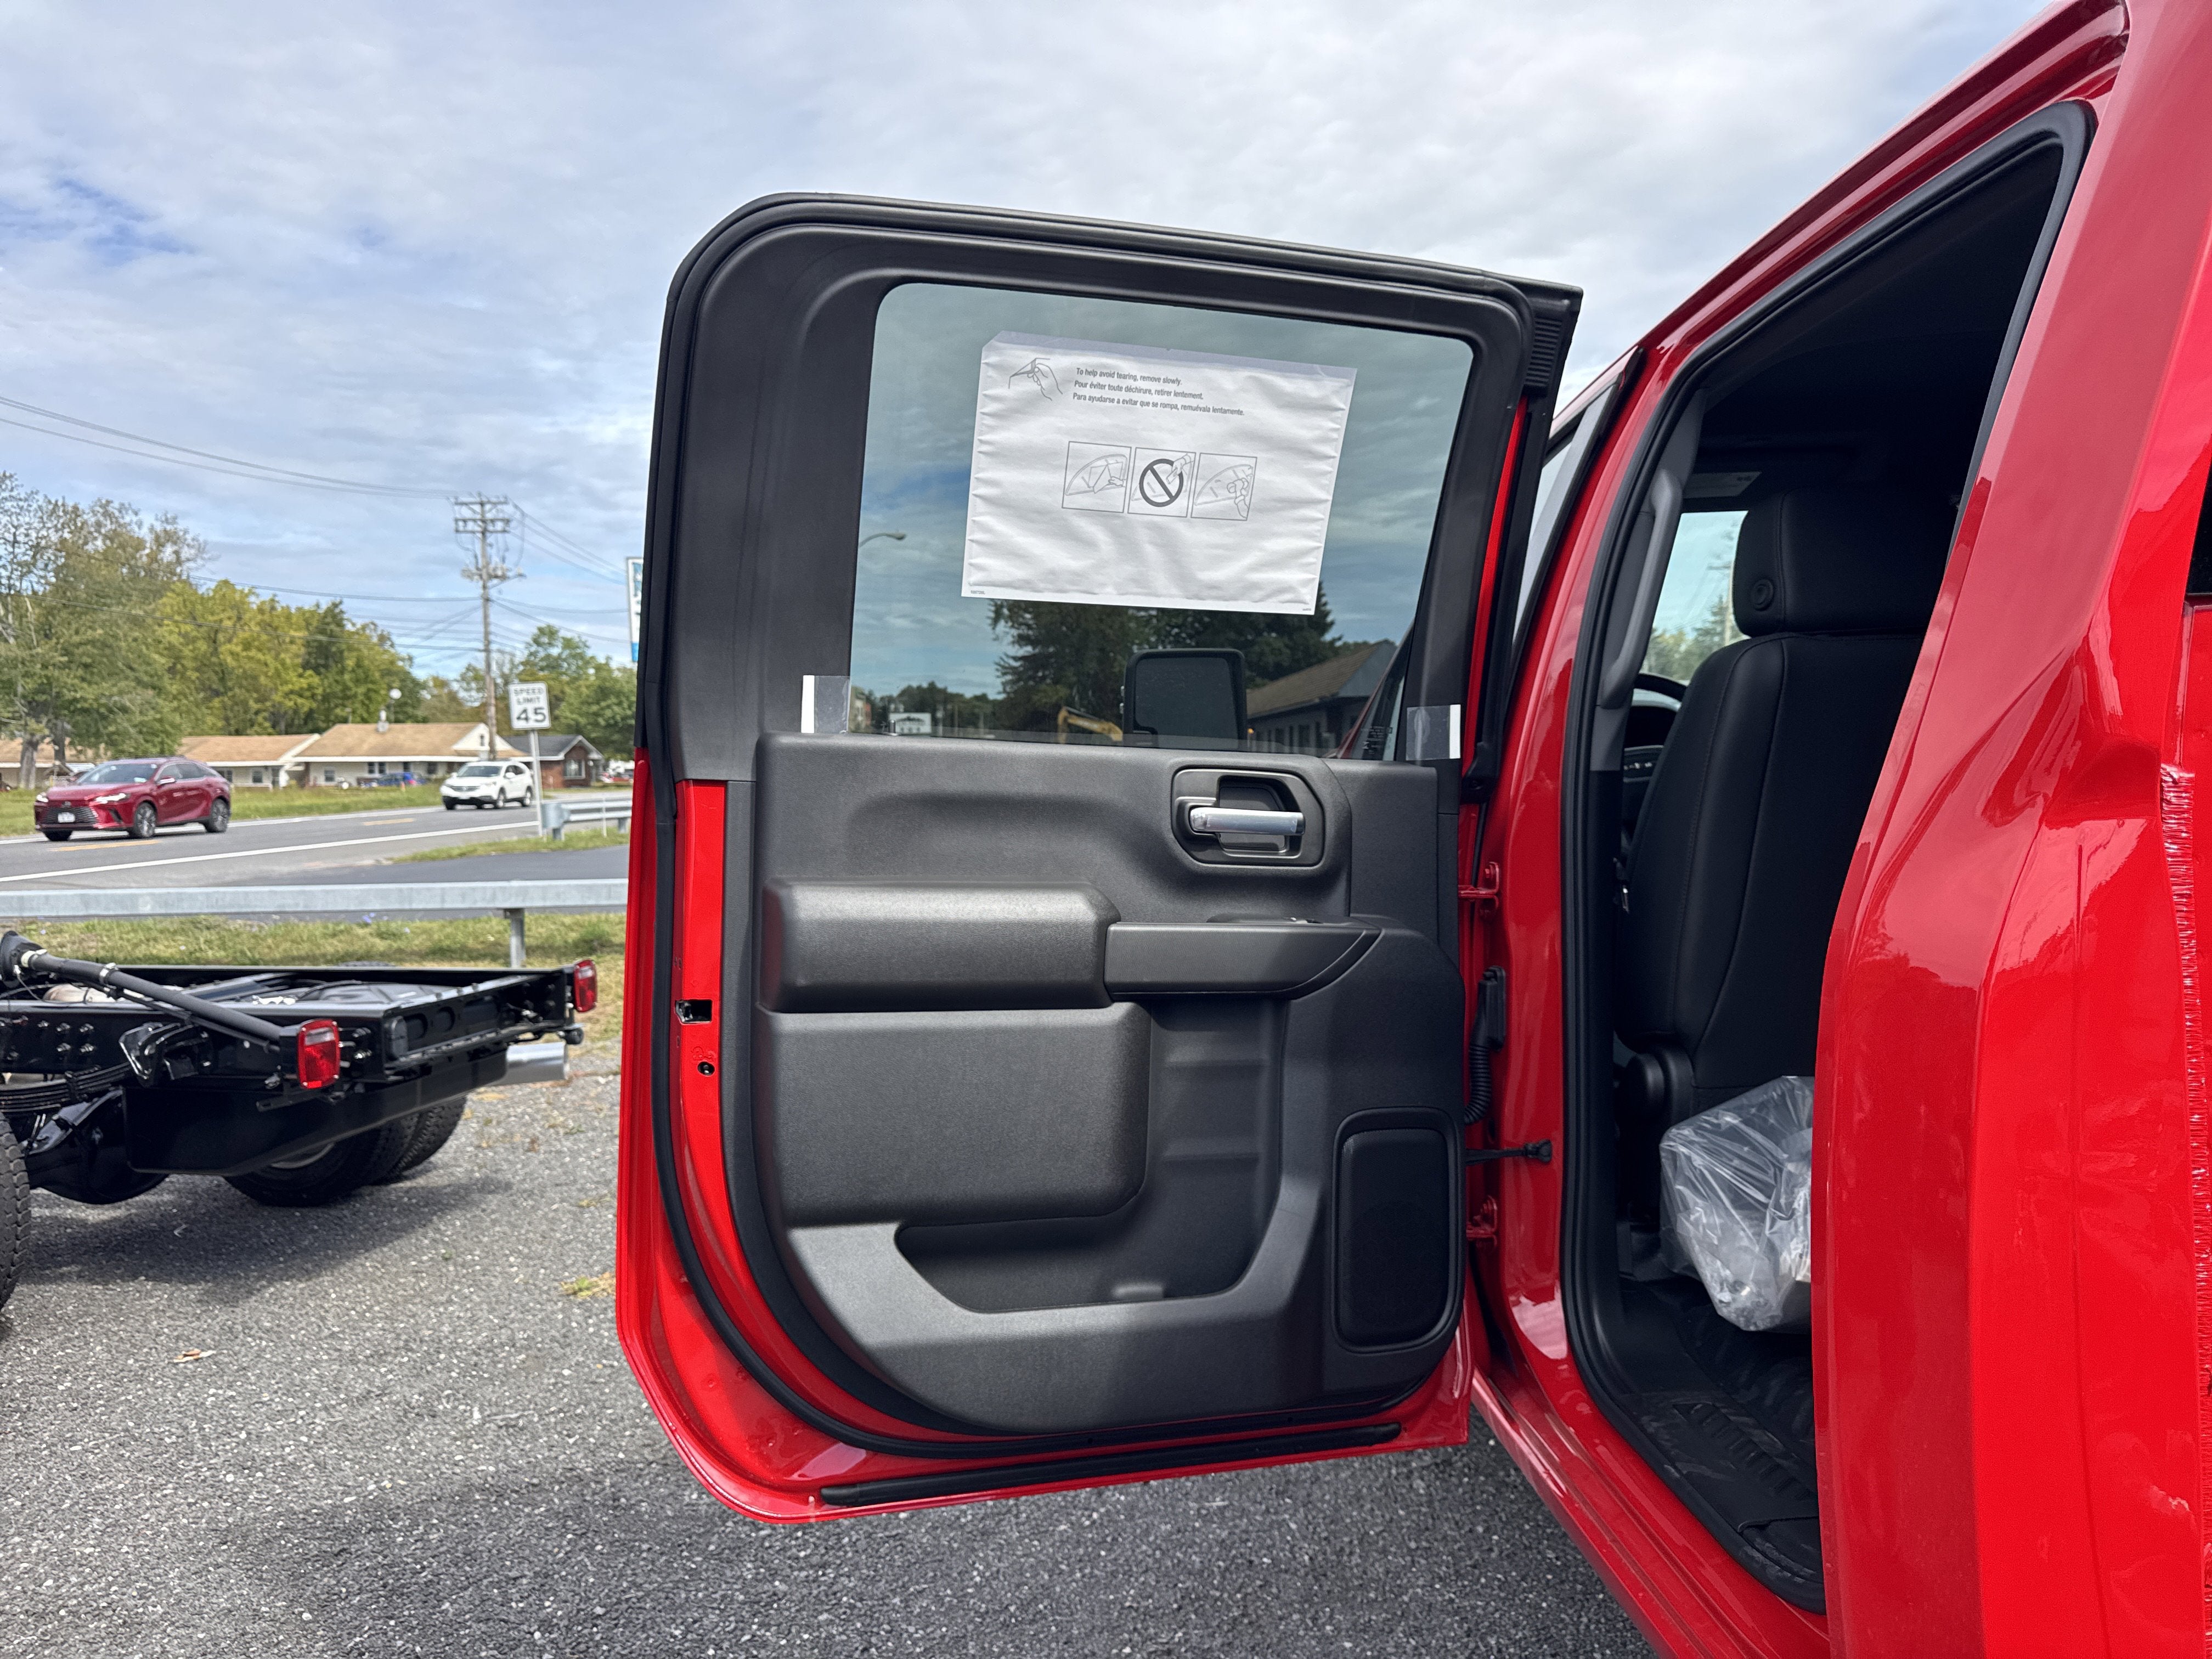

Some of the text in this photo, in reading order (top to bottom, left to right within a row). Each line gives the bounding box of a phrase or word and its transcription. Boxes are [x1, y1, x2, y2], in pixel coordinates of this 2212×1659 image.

[1085, 369, 1097, 377] help
[1117, 372, 1138, 381] tearing,
[1163, 376, 1183, 386] slowly.
[1090, 381, 1106, 390] éviter
[1125, 385, 1153, 395] déchirure,
[1174, 390, 1204, 399] lentement.
[1088, 394, 1115, 403] ayudarse
[1181, 404, 1211, 413] remuévala
[1212, 406, 1245, 415] lentamente.
[514, 687, 544, 696] SPEED
[517, 696, 541, 705] LIMIT
[516, 707, 546, 723] 45
